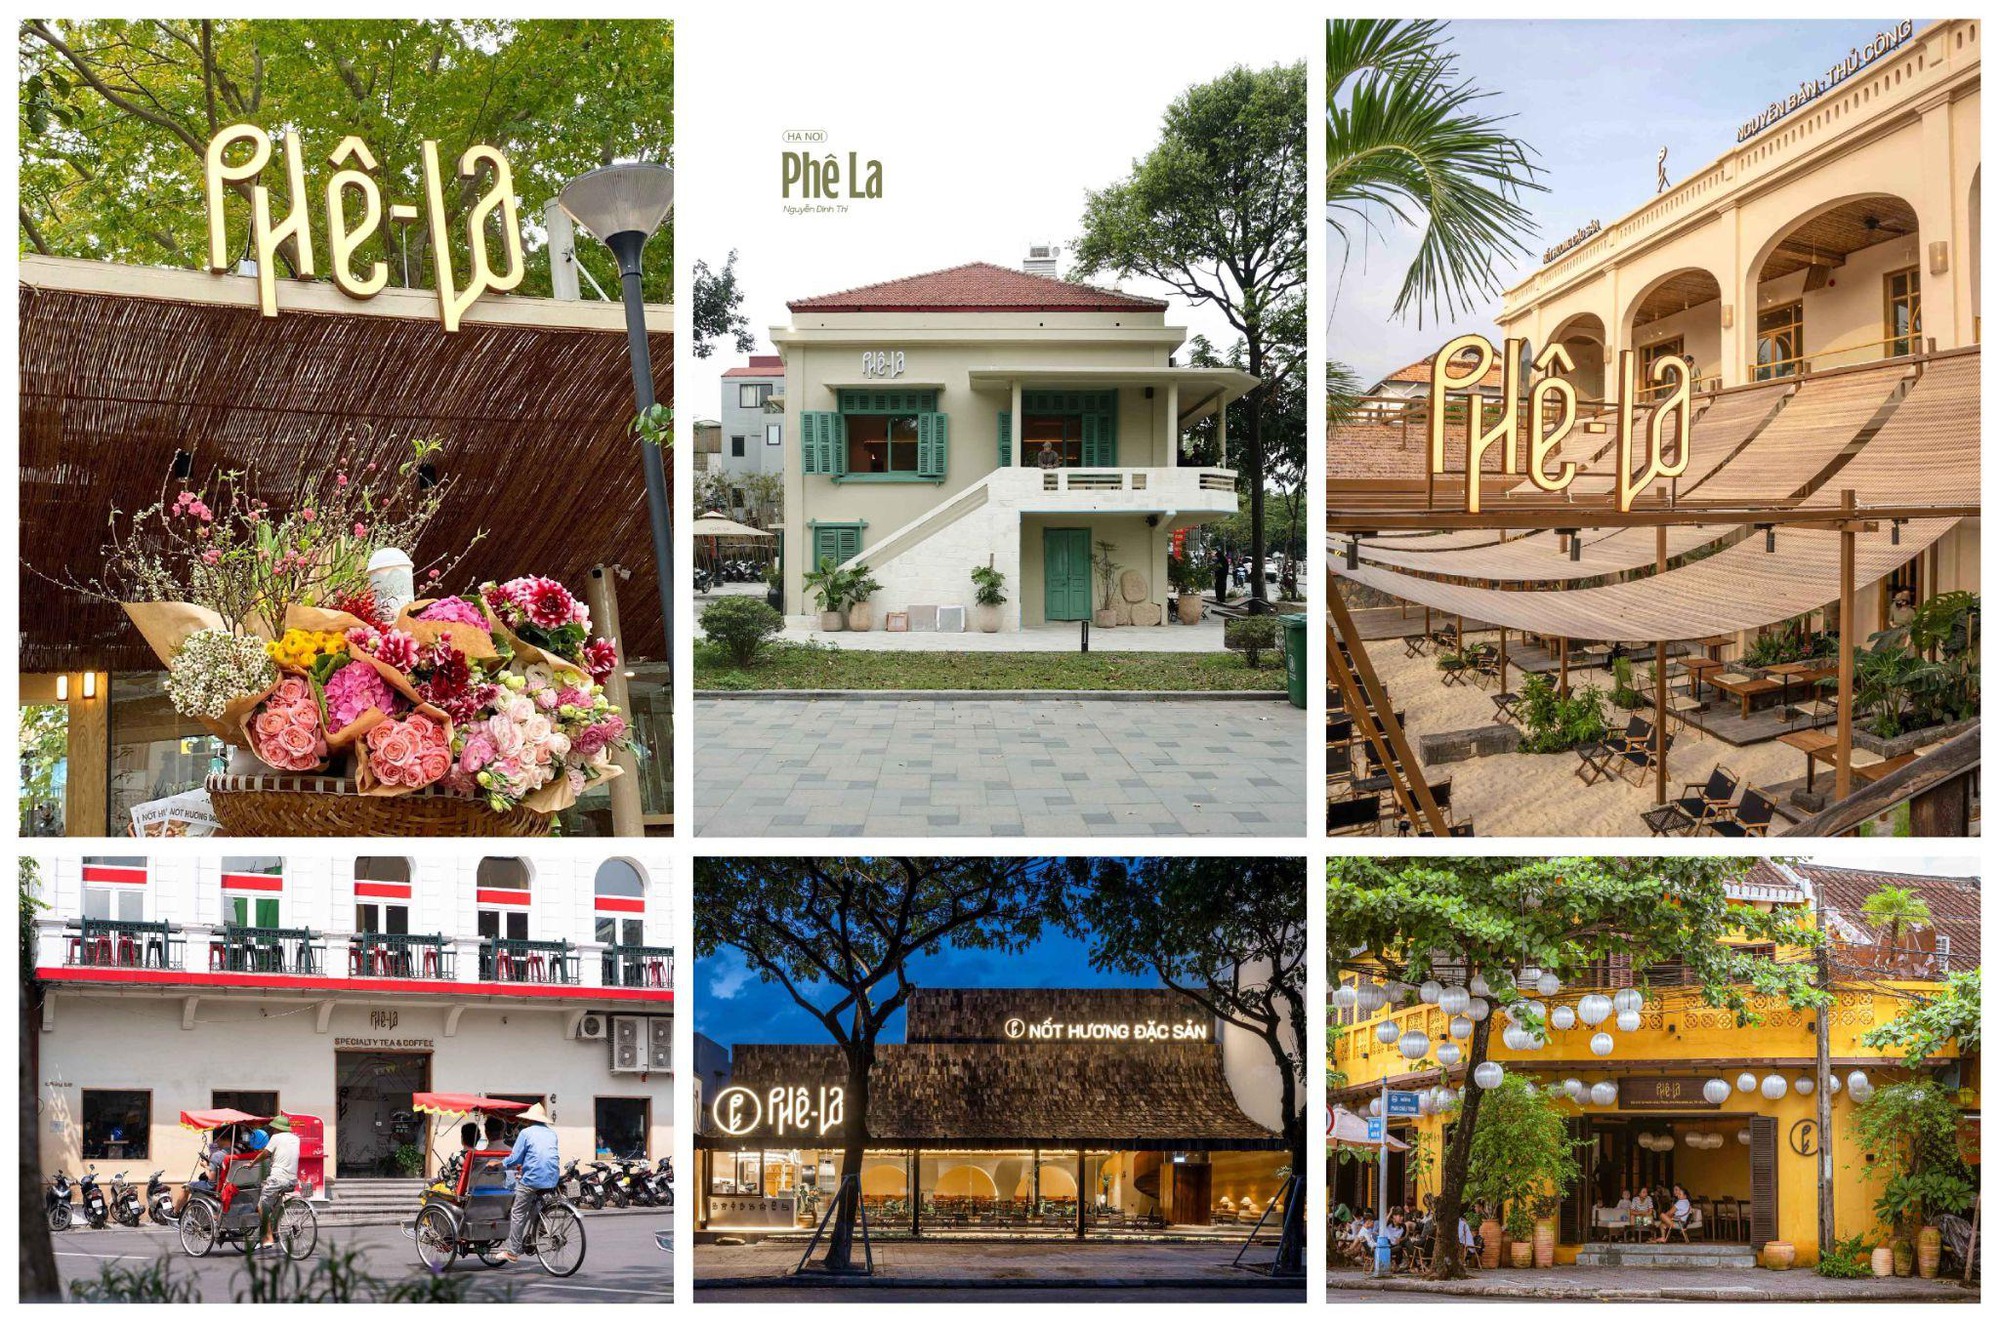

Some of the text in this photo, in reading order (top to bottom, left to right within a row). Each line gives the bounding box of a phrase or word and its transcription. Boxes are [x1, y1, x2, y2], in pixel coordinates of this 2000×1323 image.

[1862, 18, 1913, 63] CÔNG
[334, 1037, 380, 1047] SPECIALTY
[380, 1039, 396, 1047] TEA
[403, 1039, 434, 1048] COFFEE
[1029, 1017, 1207, 1043] NỐT HƯƠNG ĐẶC SẢN
